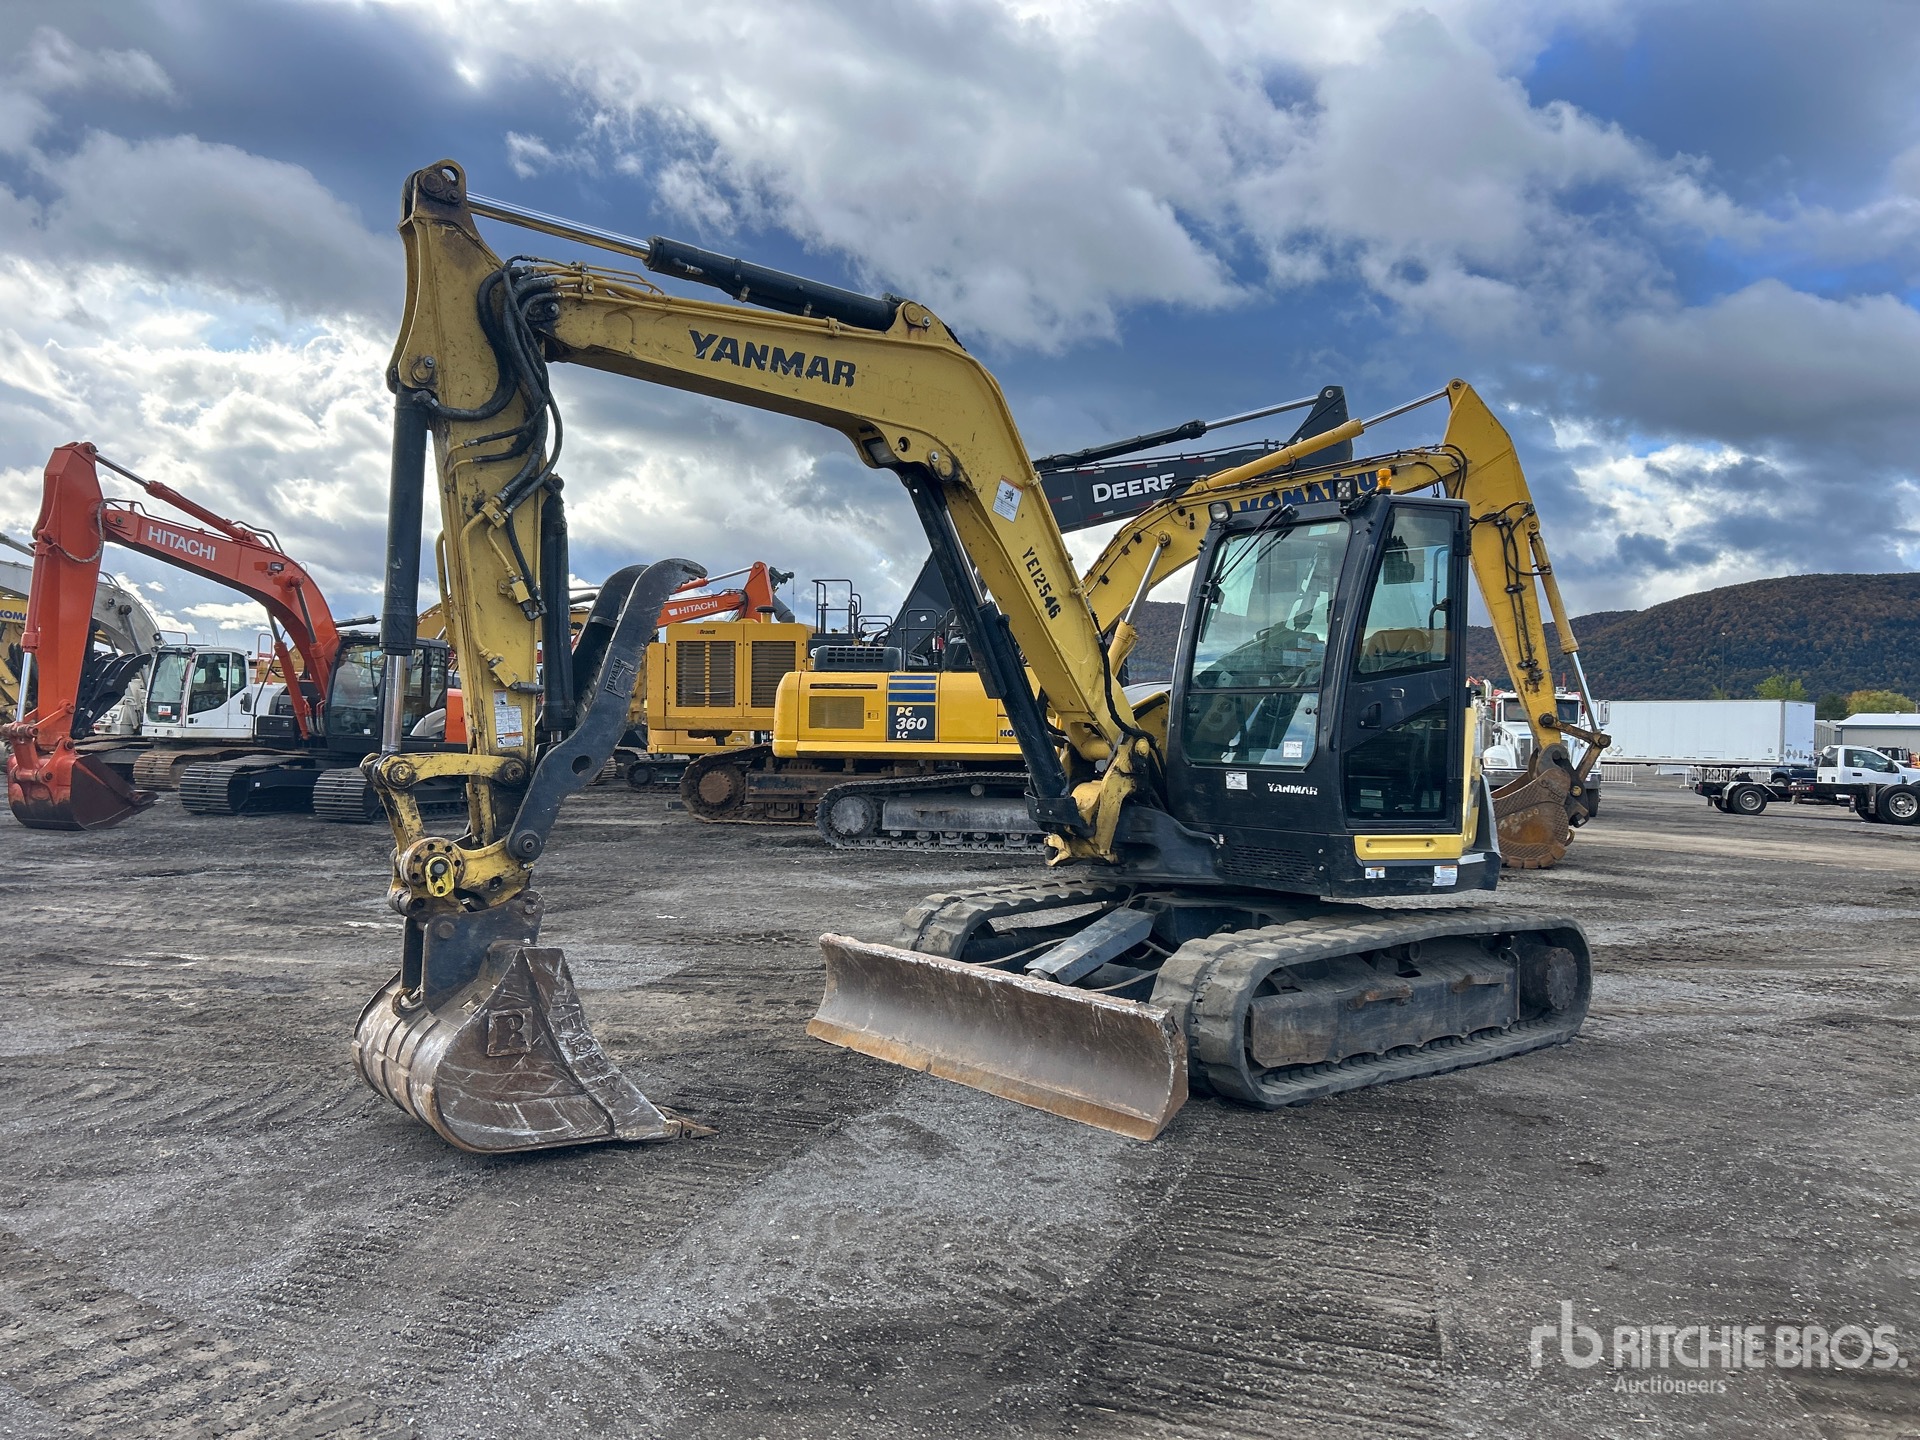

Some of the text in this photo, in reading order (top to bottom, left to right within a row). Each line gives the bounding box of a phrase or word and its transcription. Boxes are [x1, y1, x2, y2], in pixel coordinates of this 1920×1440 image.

[688, 329, 857, 388] YANMAR
[1092, 472, 1175, 503] DEERE
[1239, 472, 1378, 511] KOMATU
[147, 525, 217, 562] HITACHI
[1022, 546, 1062, 620] YE12546
[678, 600, 719, 615] HITACHI
[895, 706, 913, 717] PC
[895, 717, 928, 730] 360
[896, 730, 909, 739] LC
[1267, 782, 1318, 795] YANMAR
